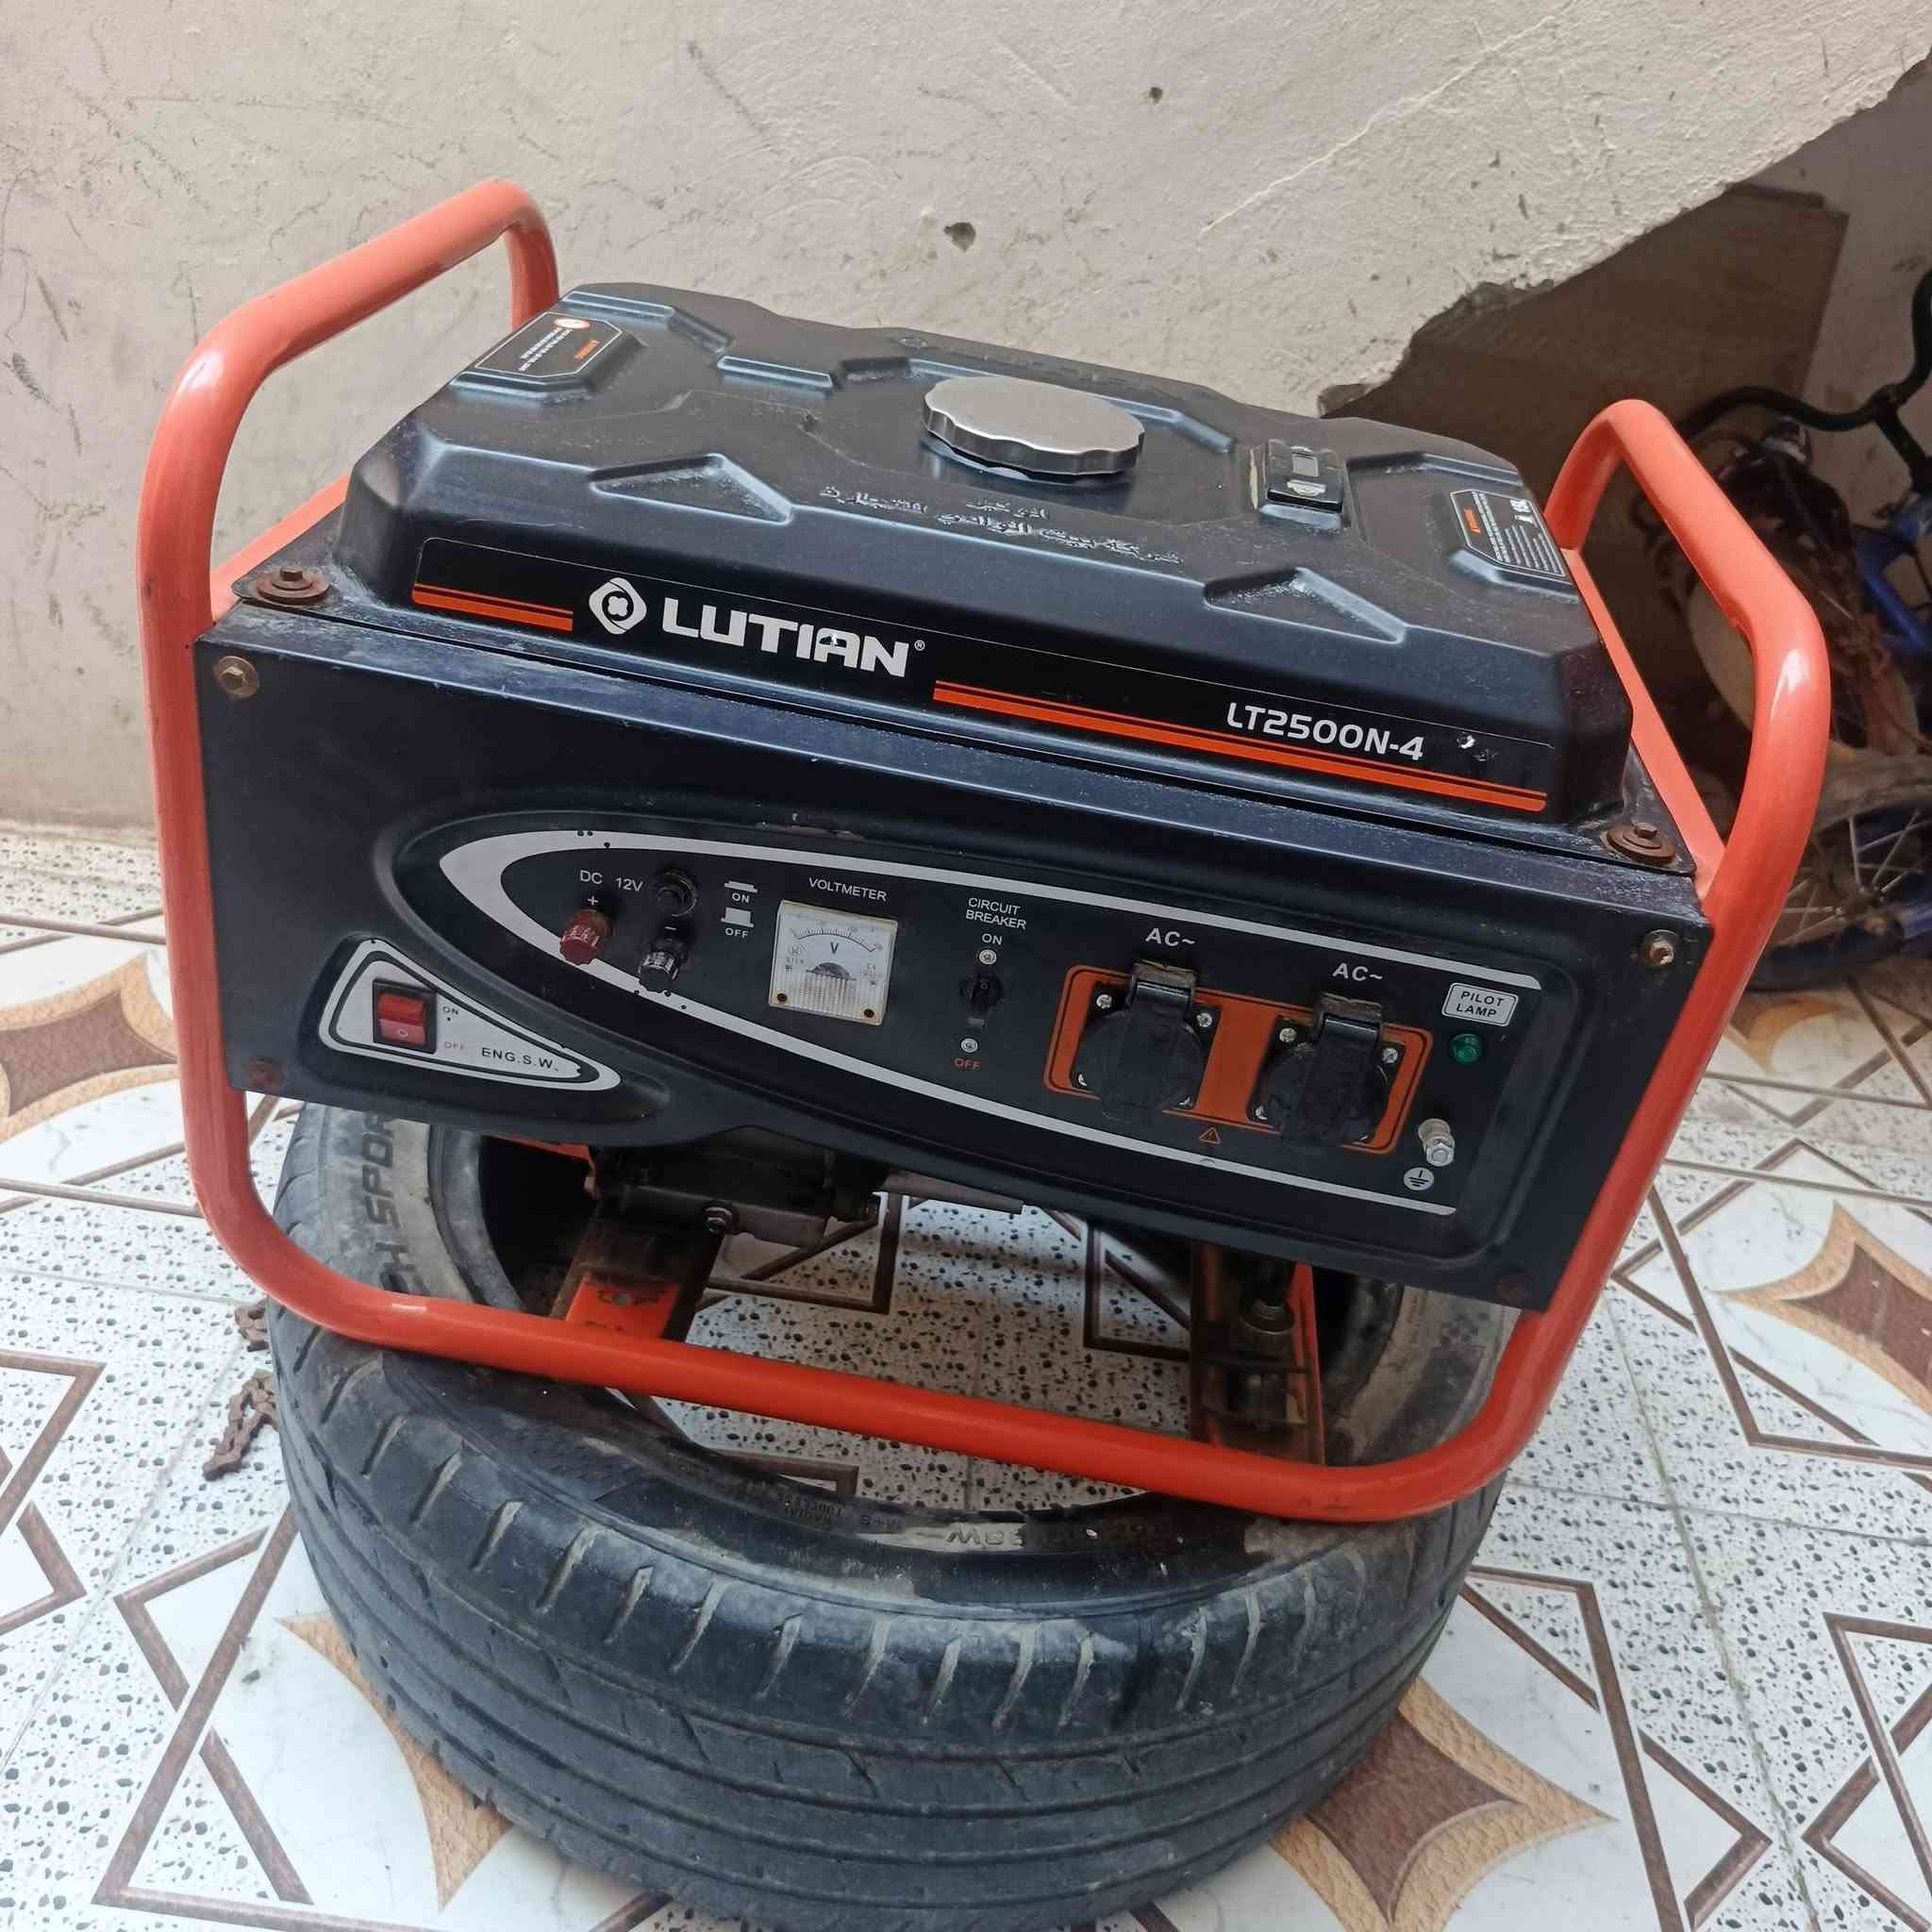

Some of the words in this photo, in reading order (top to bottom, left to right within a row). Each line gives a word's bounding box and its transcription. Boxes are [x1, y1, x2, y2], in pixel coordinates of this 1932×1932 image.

[661, 596, 910, 678] LUTIAN
[1225, 701, 1425, 761] LT2500N-4
[579, 869, 604, 885] DC
[615, 876, 644, 892] 12V
[808, 876, 888, 902] VOLTMETER
[731, 891, 751, 905] ON
[968, 897, 1022, 916] CIRCUIT
[965, 909, 1028, 930] BREAKER
[724, 926, 749, 940] OFF
[981, 932, 1004, 946] ON
[1460, 991, 1506, 1008] PILOT
[1456, 1003, 1498, 1019] LAMP
[954, 1057, 982, 1071] OFF
